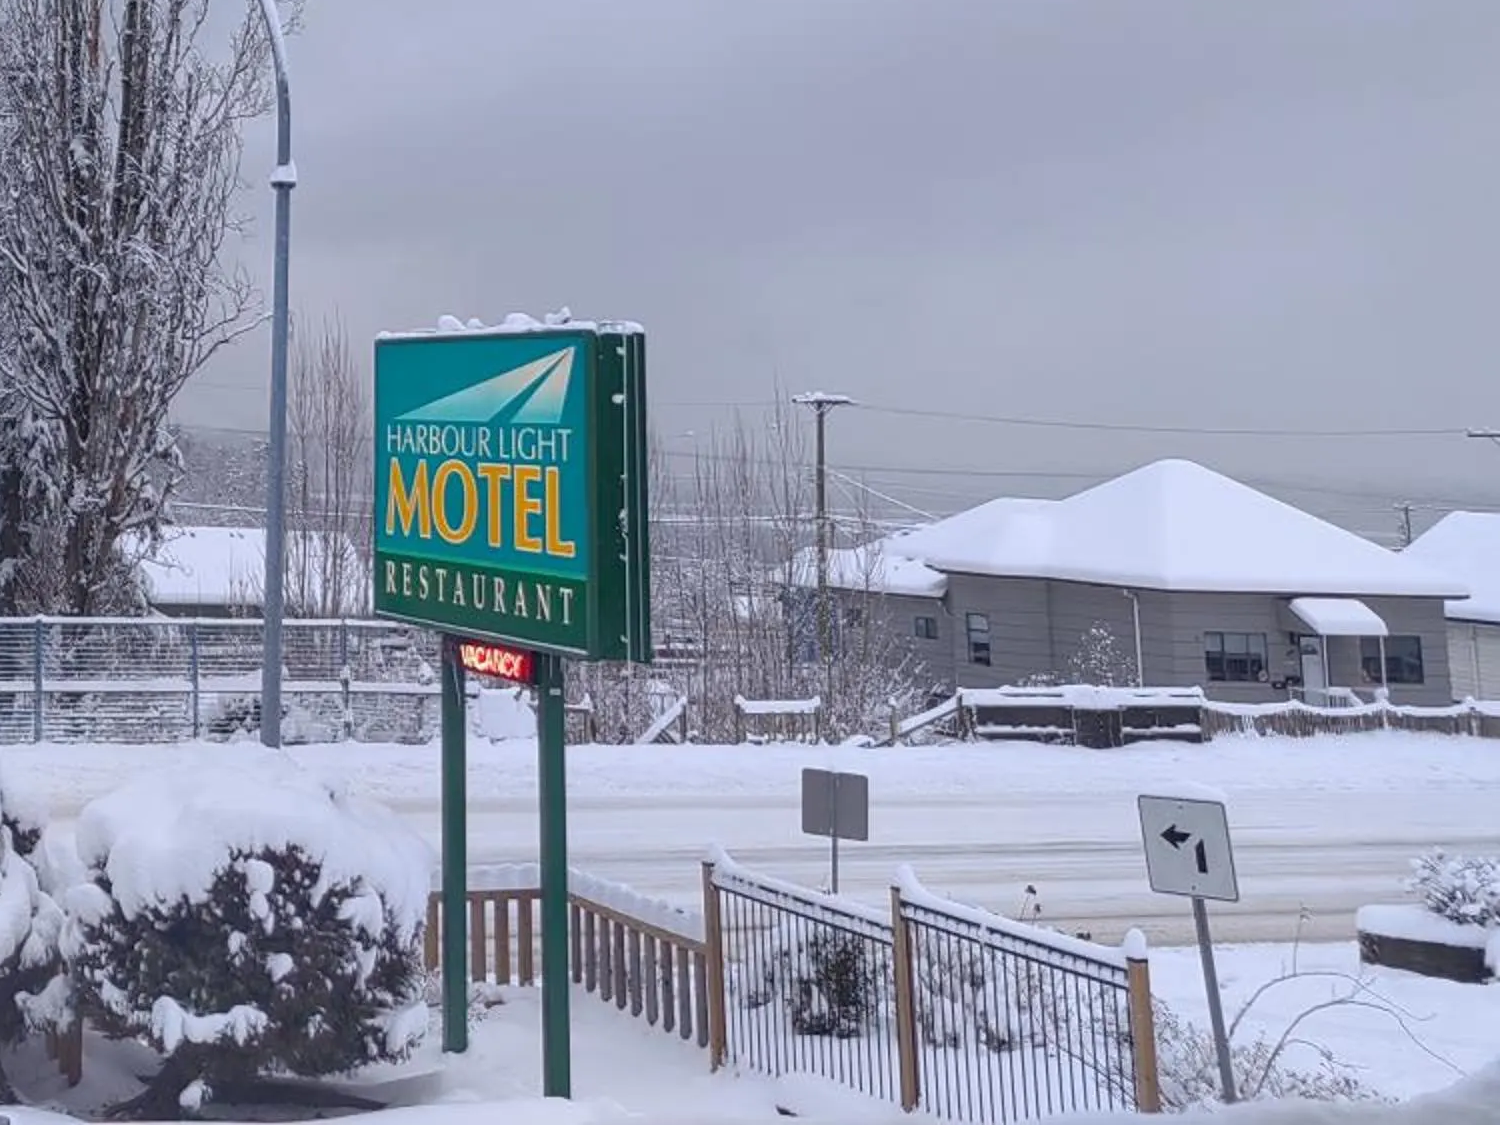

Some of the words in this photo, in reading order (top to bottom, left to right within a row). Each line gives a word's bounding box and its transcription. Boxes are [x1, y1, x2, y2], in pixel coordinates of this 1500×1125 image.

[387, 424, 493, 458] HARBOUR
[499, 427, 572, 462] LIGHT
[385, 457, 576, 558] MOTEL
[385, 560, 574, 625] RESTAURANT
